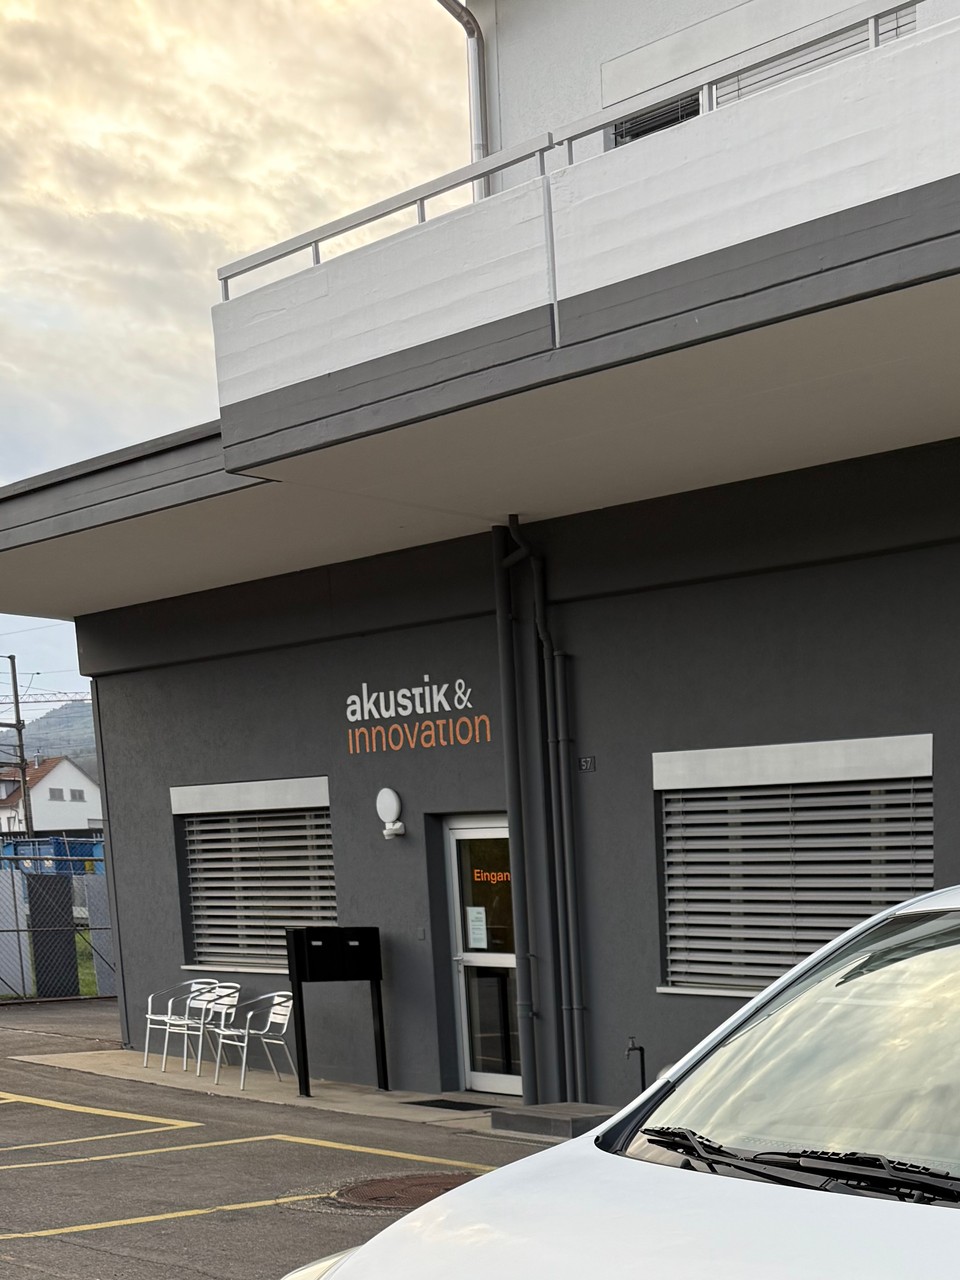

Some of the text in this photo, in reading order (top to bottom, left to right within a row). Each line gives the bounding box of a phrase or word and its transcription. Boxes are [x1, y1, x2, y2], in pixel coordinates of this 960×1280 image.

[346, 674, 473, 722] akustik &
[348, 714, 492, 754] innovation
[473, 869, 511, 884] Eingan
